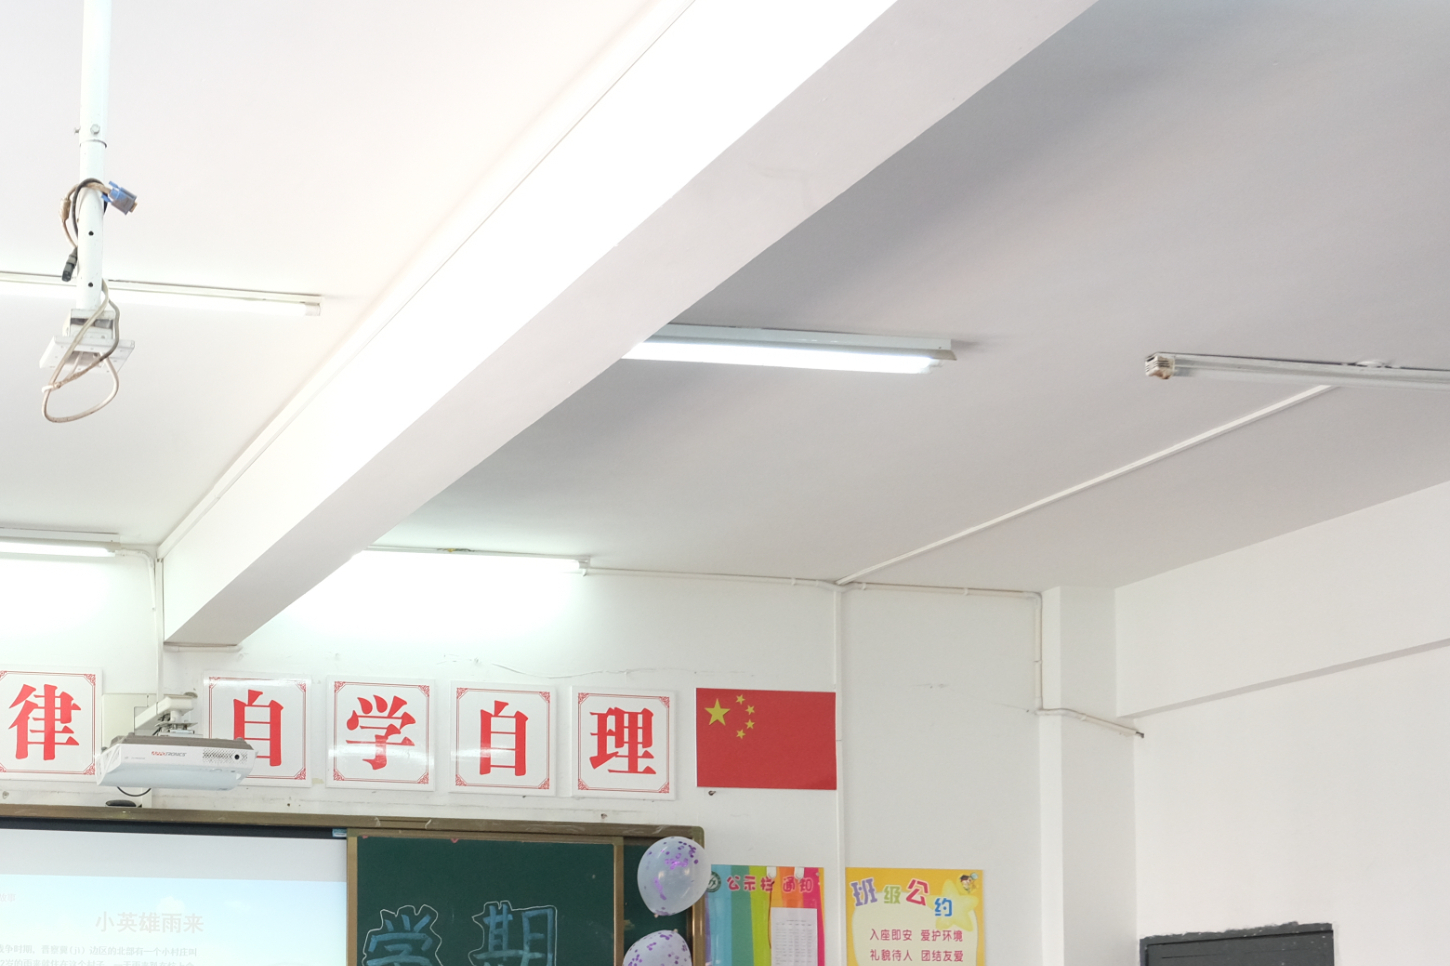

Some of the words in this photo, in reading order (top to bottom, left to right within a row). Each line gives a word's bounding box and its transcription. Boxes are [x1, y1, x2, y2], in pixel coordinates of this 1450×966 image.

[726, 875, 774, 893] 公示栏
[782, 877, 814, 893] 通知
[851, 878, 953, 917] 班级公约
[95, 911, 204, 934] 小英雄雨来
[869, 929, 912, 942] 入座即安
[920, 929, 962, 942] 爱护环境
[870, 950, 913, 963] 礼貌待人
[921, 950, 963, 963] 团结友爱
